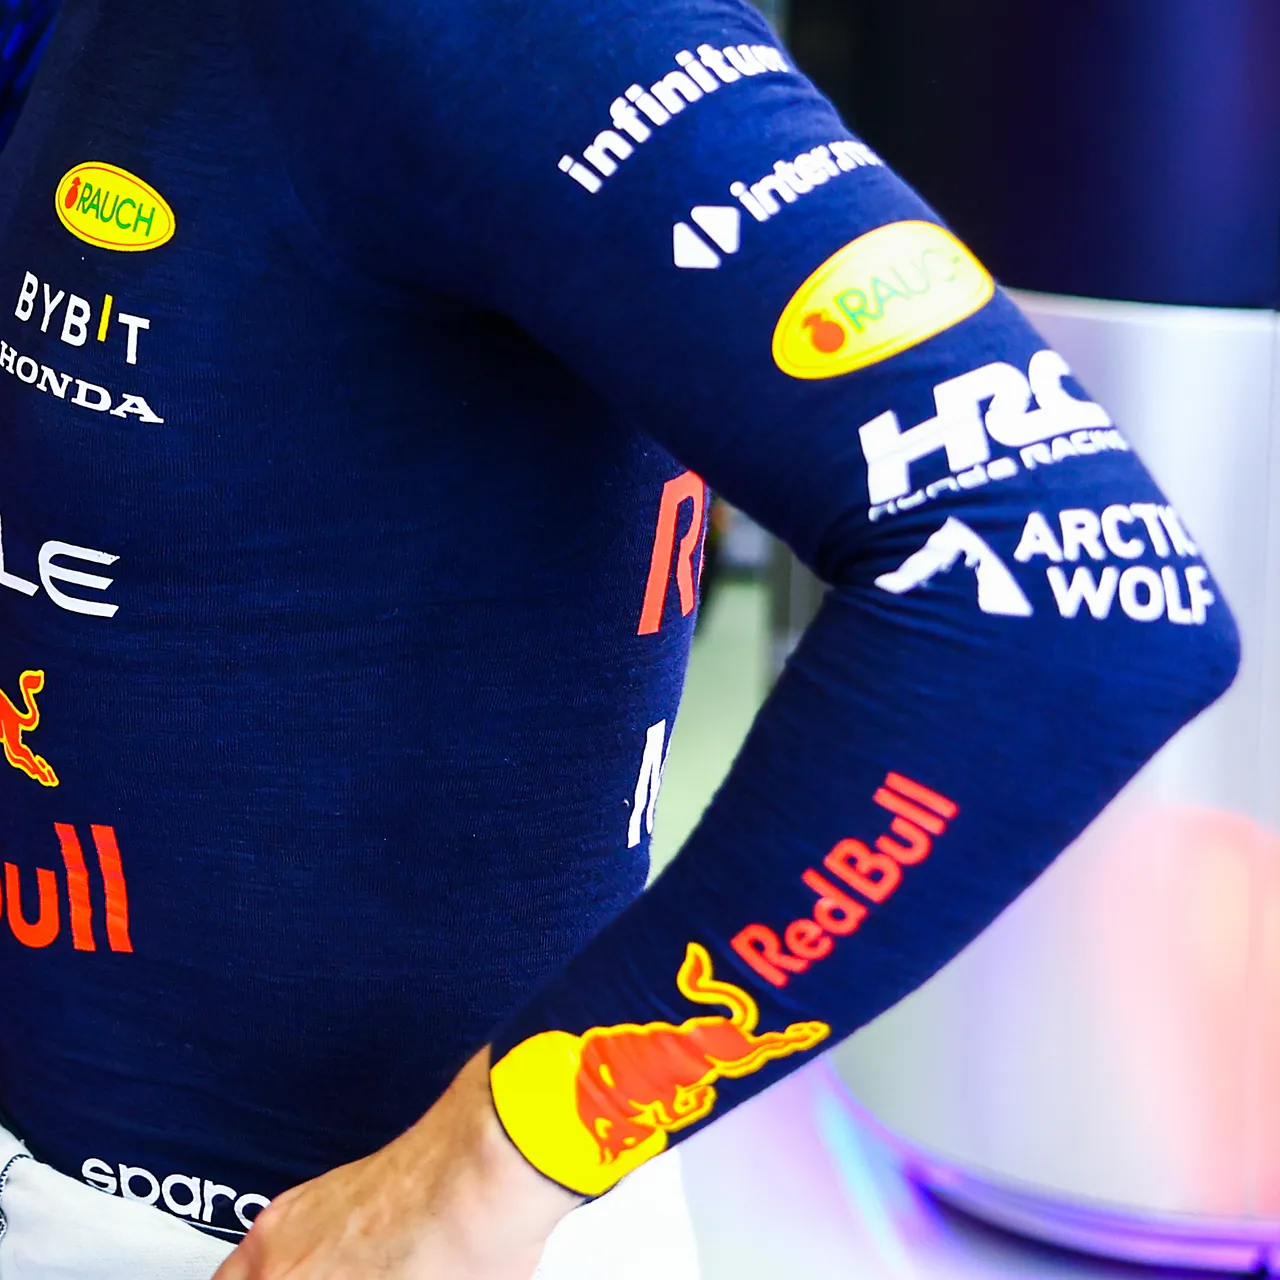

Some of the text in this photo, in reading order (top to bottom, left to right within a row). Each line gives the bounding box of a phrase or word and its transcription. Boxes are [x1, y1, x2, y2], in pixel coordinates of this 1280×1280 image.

[557, 43, 789, 194] infinitum
[75, 182, 156, 237] RAUCH
[14, 271, 150, 365] BYBIT
[834, 247, 962, 332] RAUC
[858, 350, 1112, 507] HRC
[1046, 565, 1216, 626] WOLF
